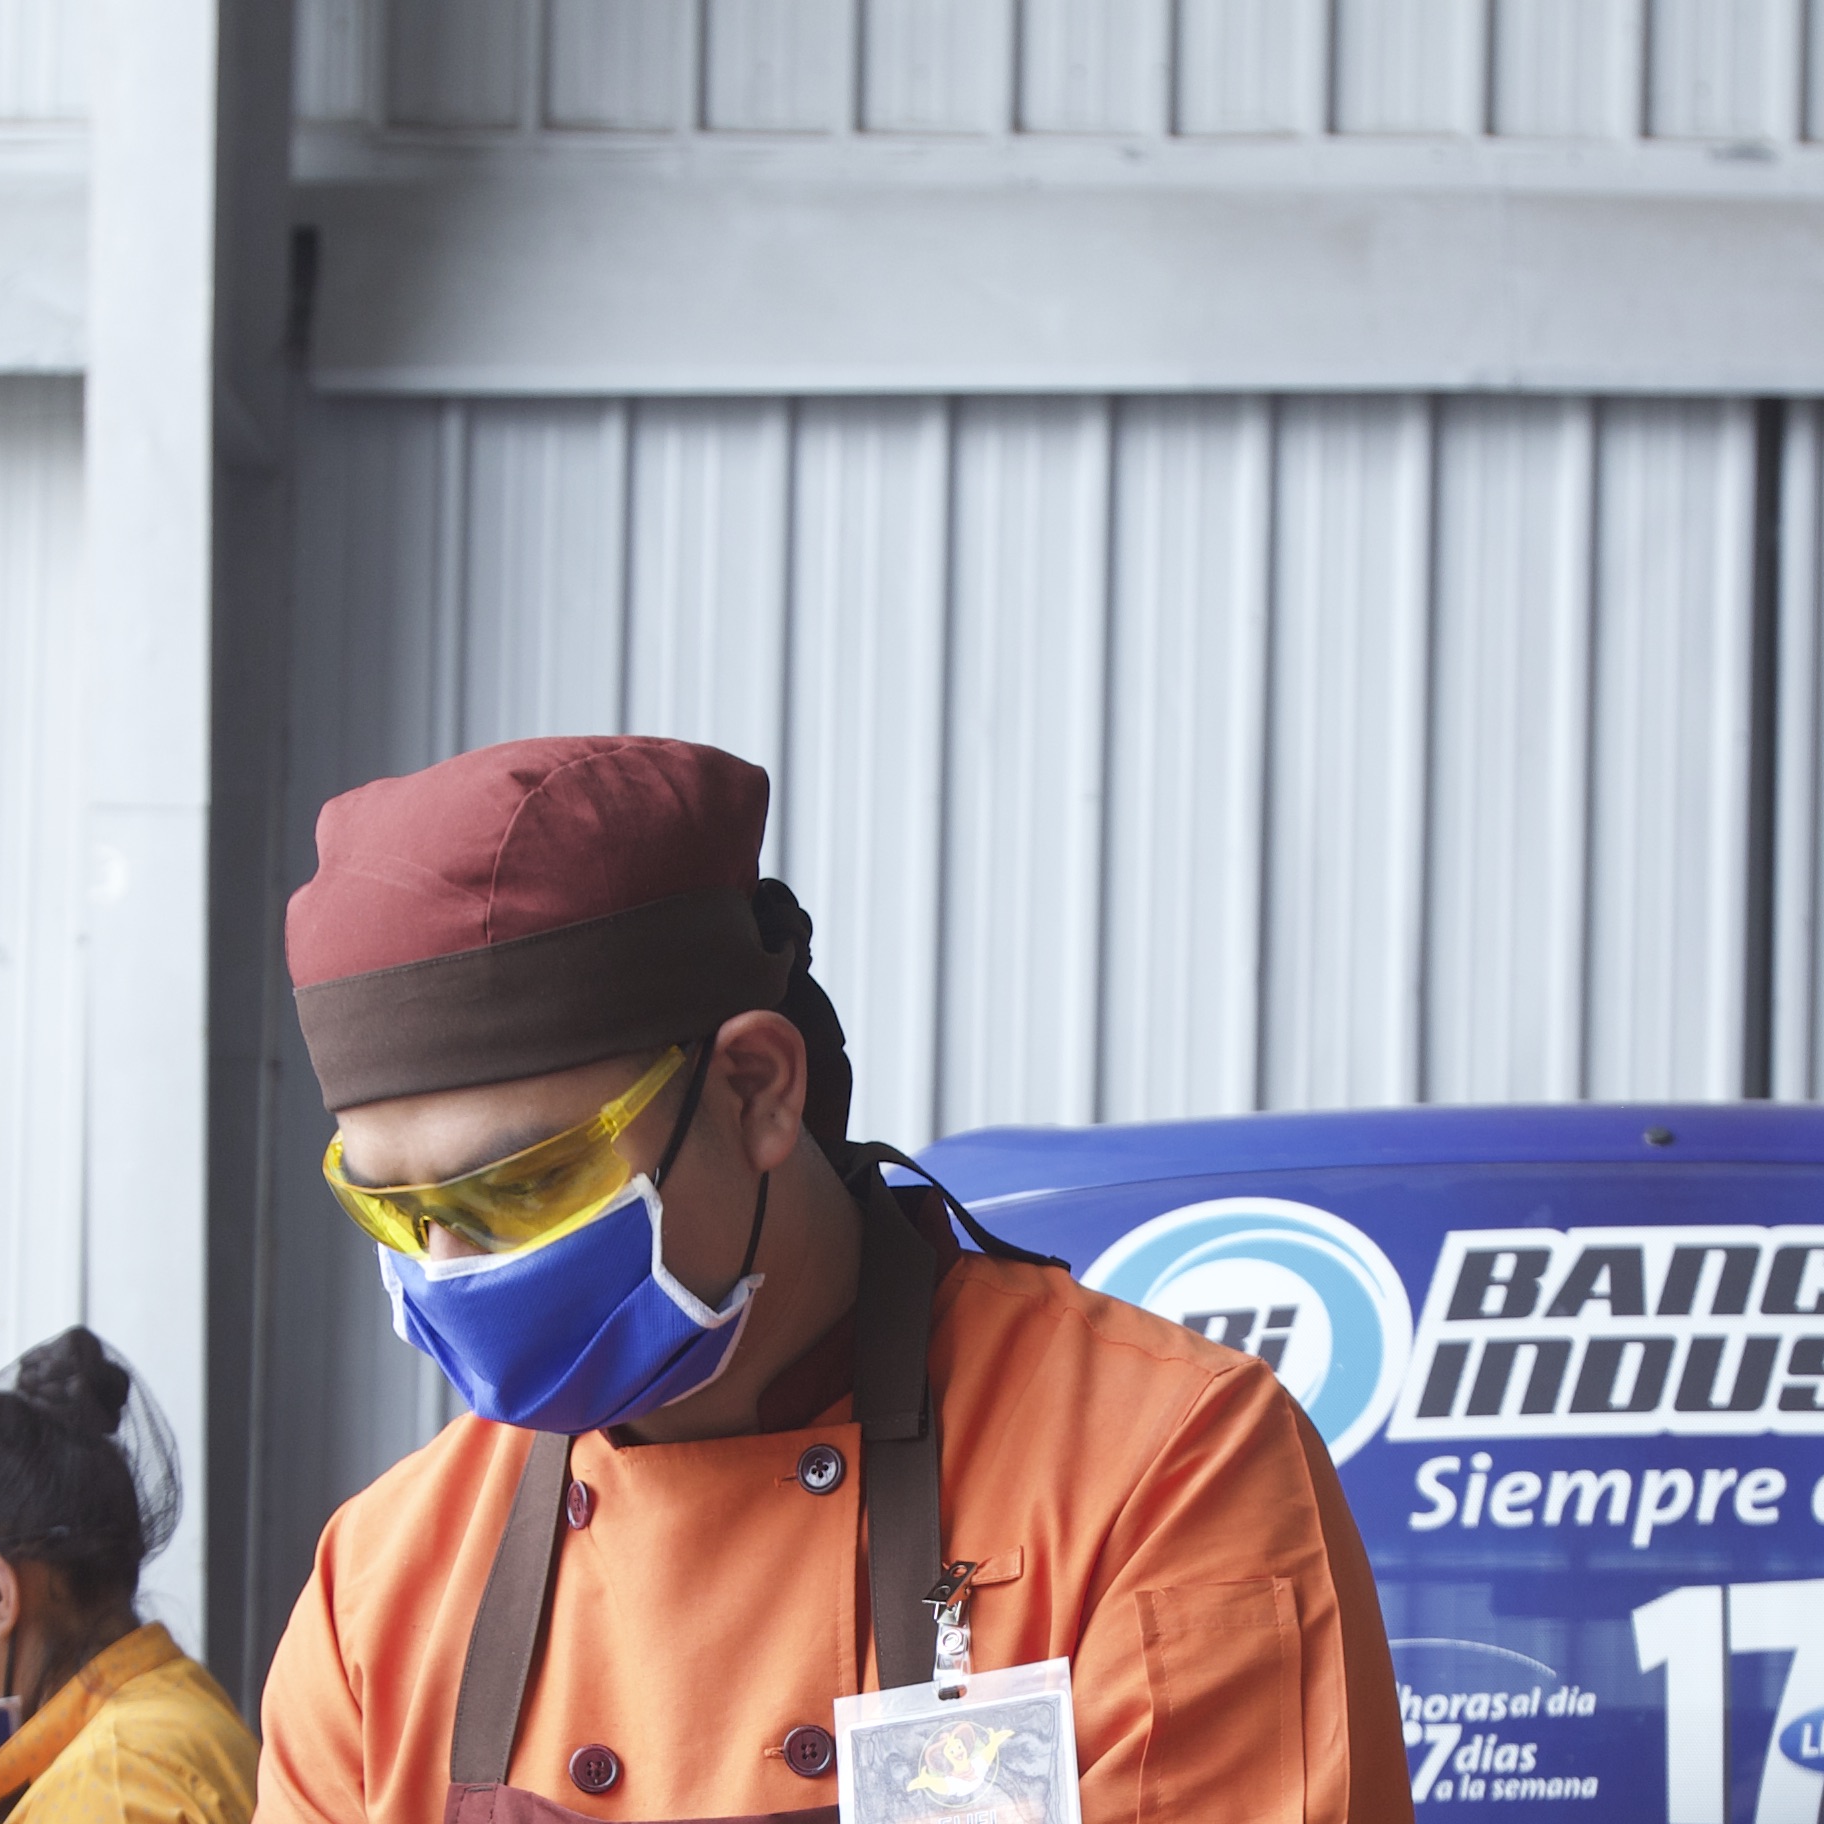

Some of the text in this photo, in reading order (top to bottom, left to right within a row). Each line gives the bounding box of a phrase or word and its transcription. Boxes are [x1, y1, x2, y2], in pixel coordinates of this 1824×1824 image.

[1408, 1450, 1787, 1549] Siempre
[1400, 1684, 1509, 1722] horas
[1509, 1686, 1542, 1718] al
[1459, 1773, 1486, 1801] la
[1491, 1776, 1599, 1800] semana
